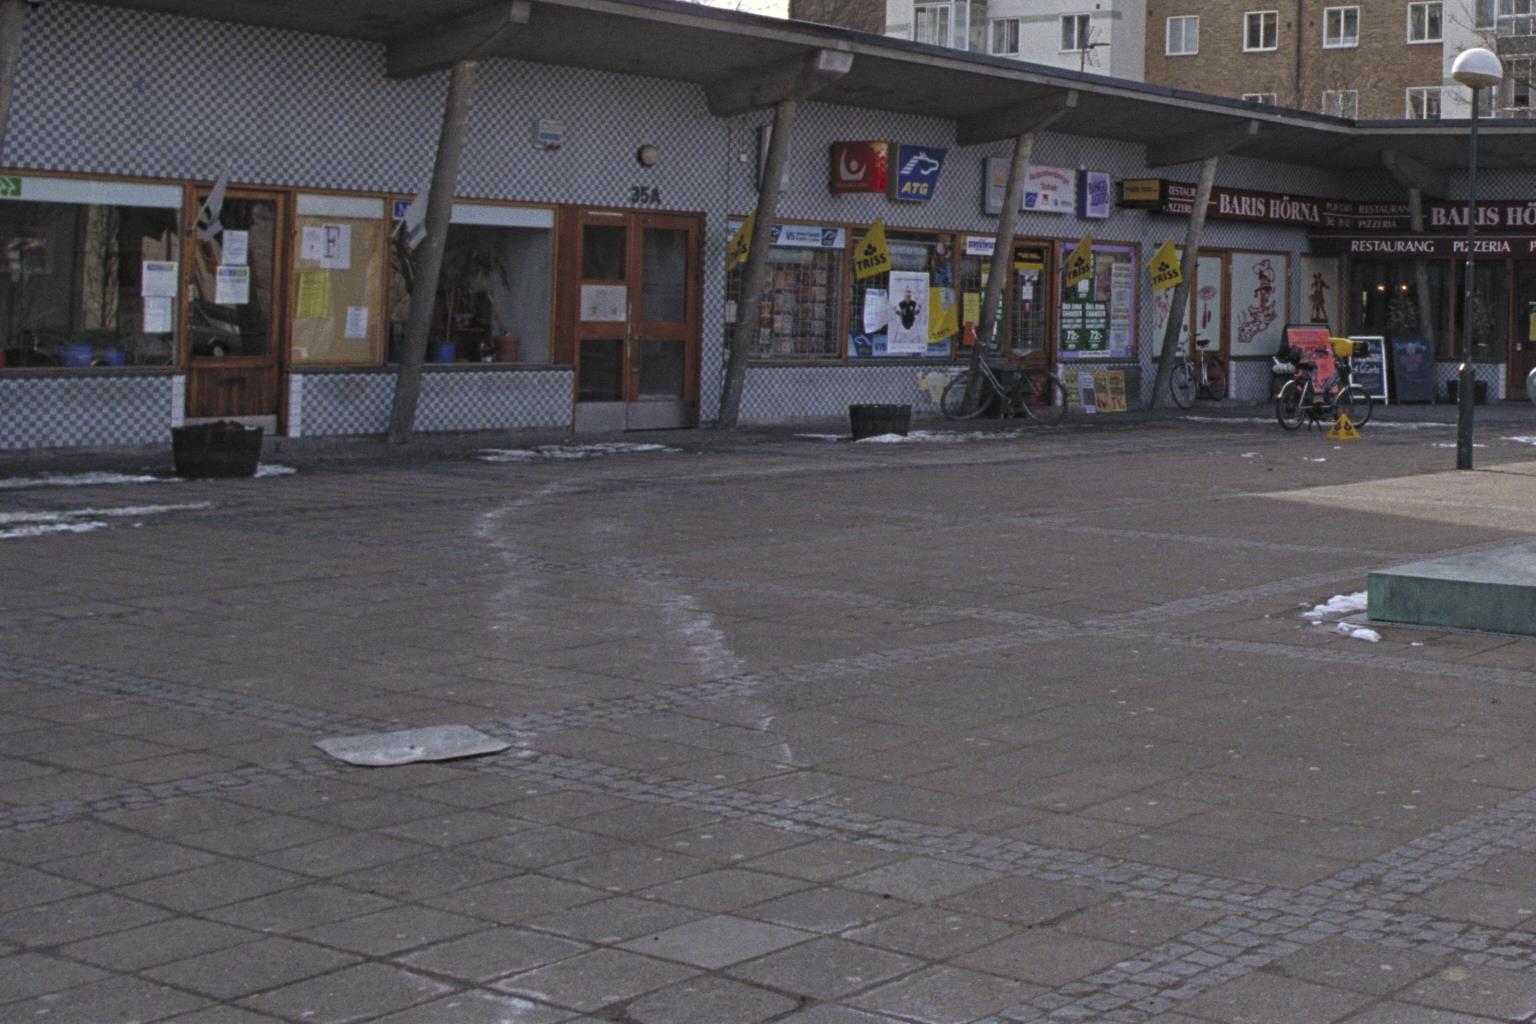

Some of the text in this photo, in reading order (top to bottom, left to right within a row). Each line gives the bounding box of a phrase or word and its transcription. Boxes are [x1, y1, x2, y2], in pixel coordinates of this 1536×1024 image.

[901, 181, 929, 196] ATG
[1219, 193, 1320, 223] BARIS HÖRNA
[1359, 204, 1410, 214] RESTAURAN
[323, 226, 340, 259] F
[1351, 239, 1435, 253] RESTAURANG
[1453, 239, 1510, 253] PIZZERIA
[856, 253, 887, 271] TRISS
[1067, 263, 1090, 281] TRISS
[1152, 269, 1179, 285] TRISS
